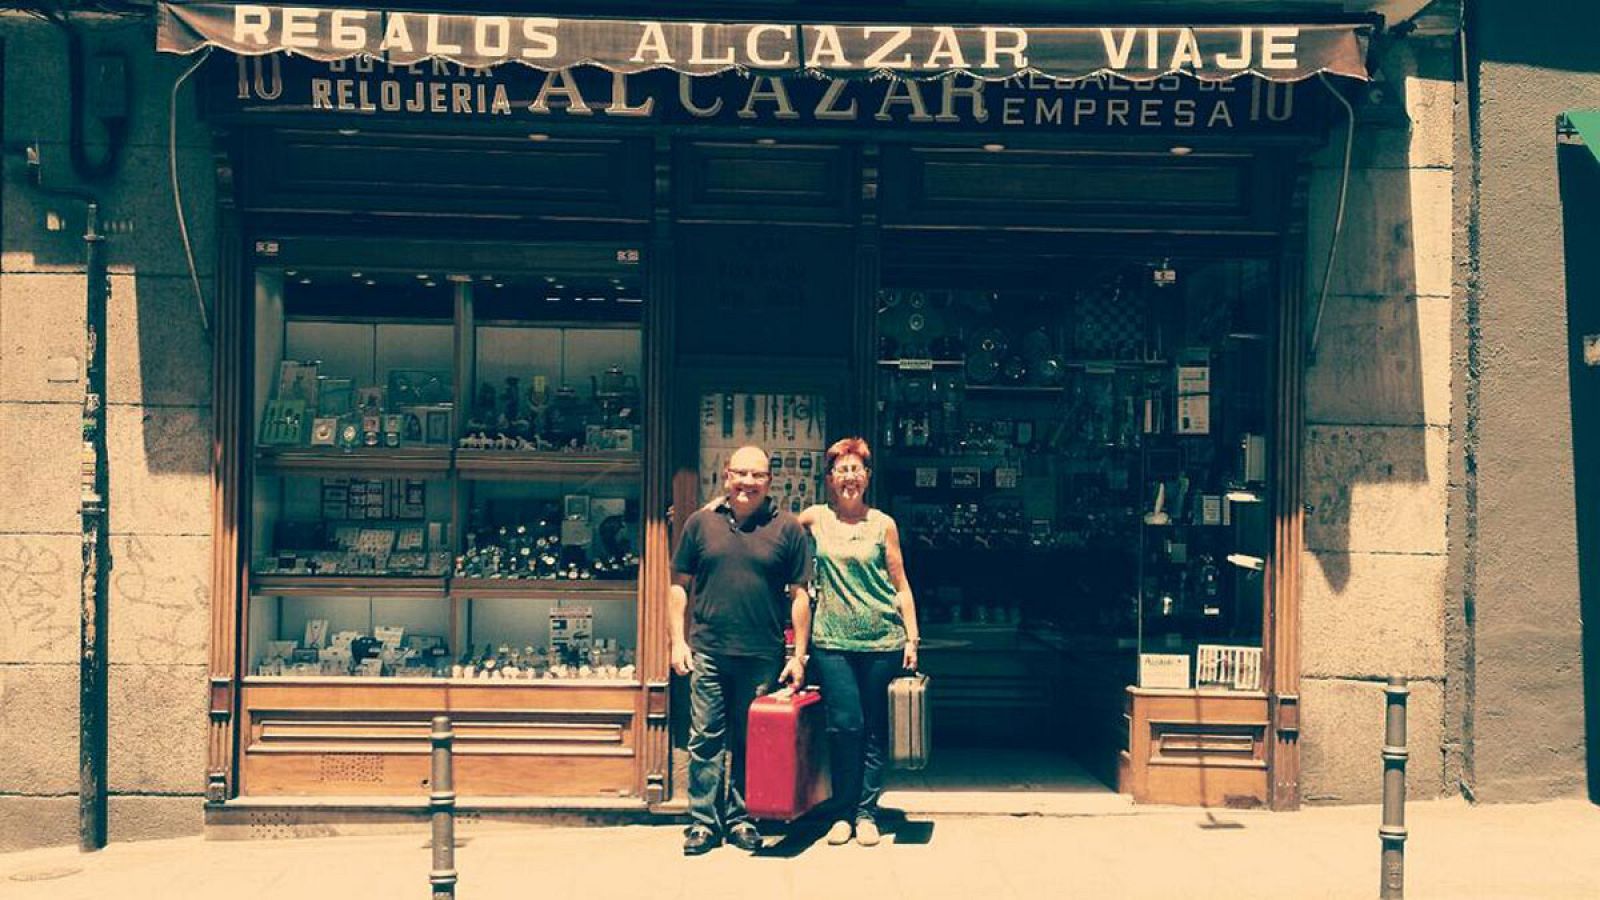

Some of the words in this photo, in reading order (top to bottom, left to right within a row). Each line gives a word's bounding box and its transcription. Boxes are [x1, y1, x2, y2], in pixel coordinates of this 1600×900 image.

[232, 4, 559, 58] REGALOS
[629, 21, 1029, 69] ALCAZAR
[1100, 26, 1300, 70] VIAJE
[311, 78, 512, 115] RELOJERIA
[527, 66, 989, 124] ALCAZAR
[1002, 98, 1234, 127] EMPRESA
